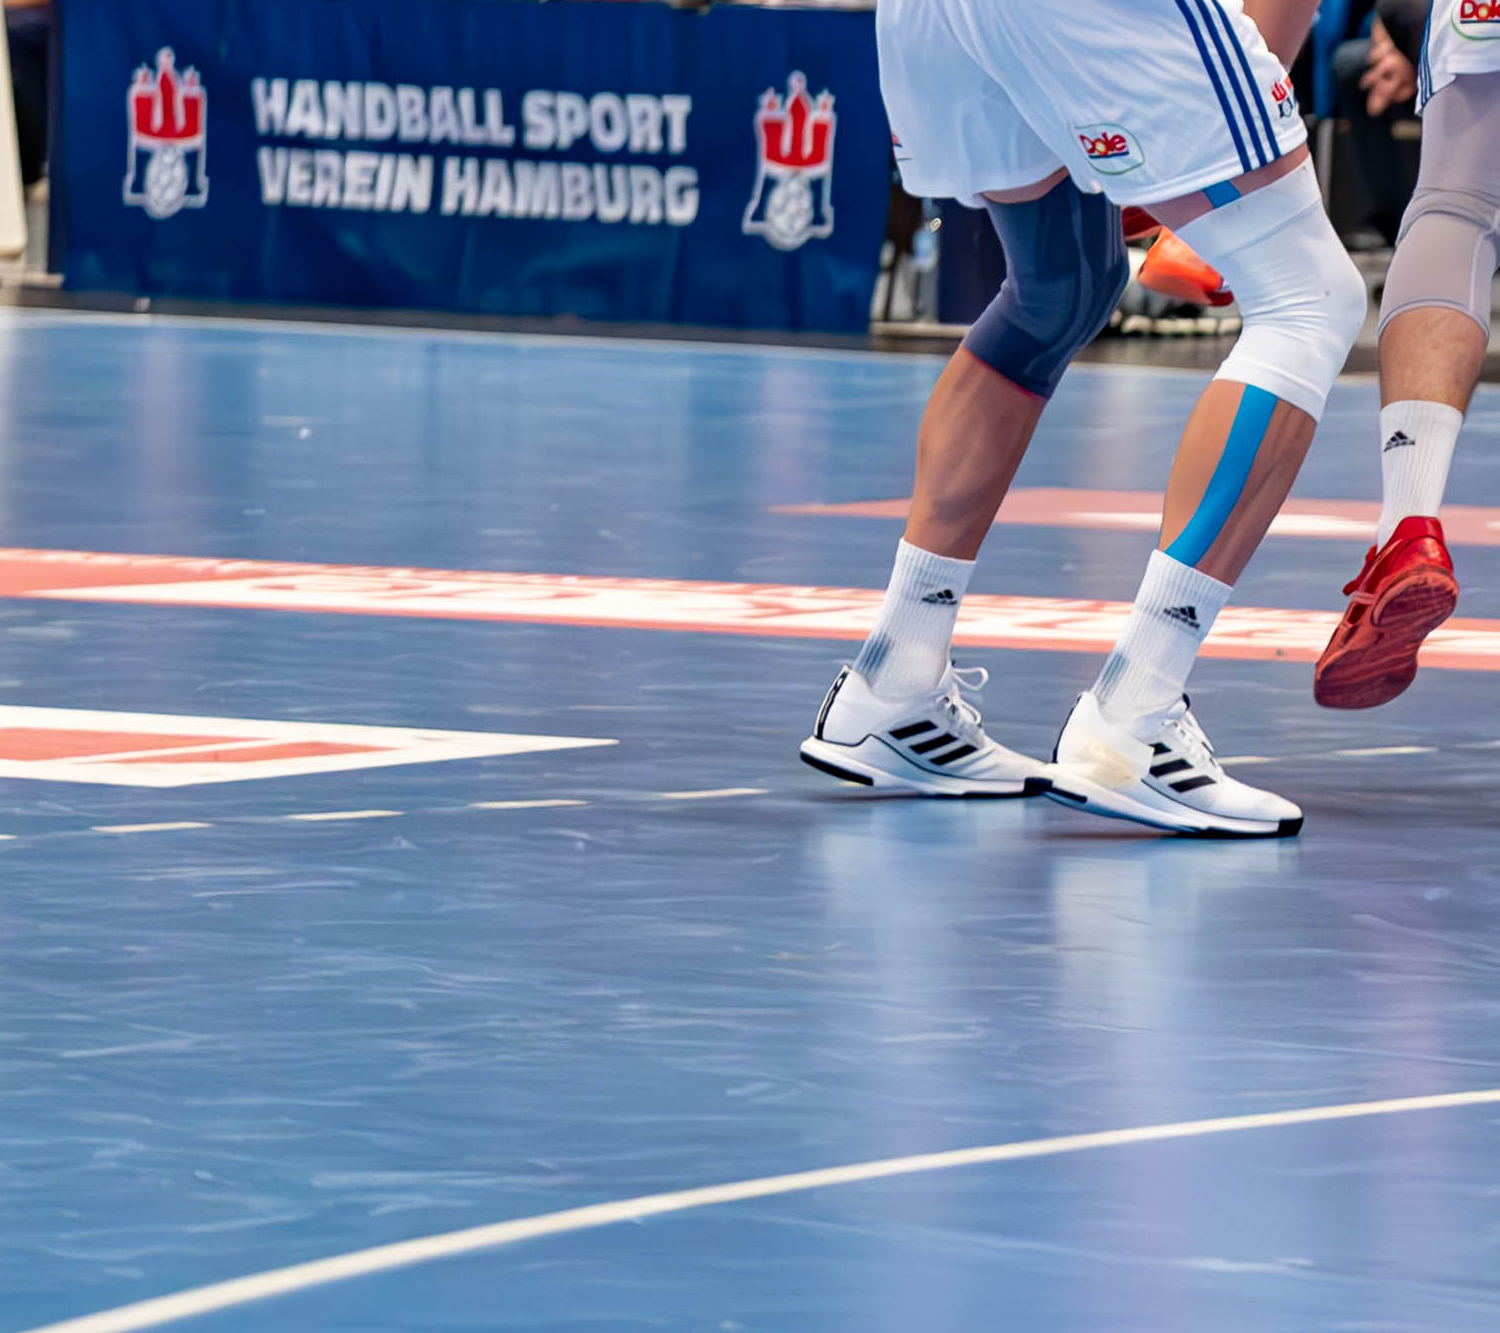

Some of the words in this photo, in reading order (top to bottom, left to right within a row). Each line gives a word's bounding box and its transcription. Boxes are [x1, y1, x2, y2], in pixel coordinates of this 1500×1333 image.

[252, 77, 515, 147] HANDBALL
[522, 89, 693, 154] SPORT
[1078, 130, 1128, 157] Dole
[257, 146, 434, 213] VEREIN
[440, 156, 700, 226] HAMBURG
